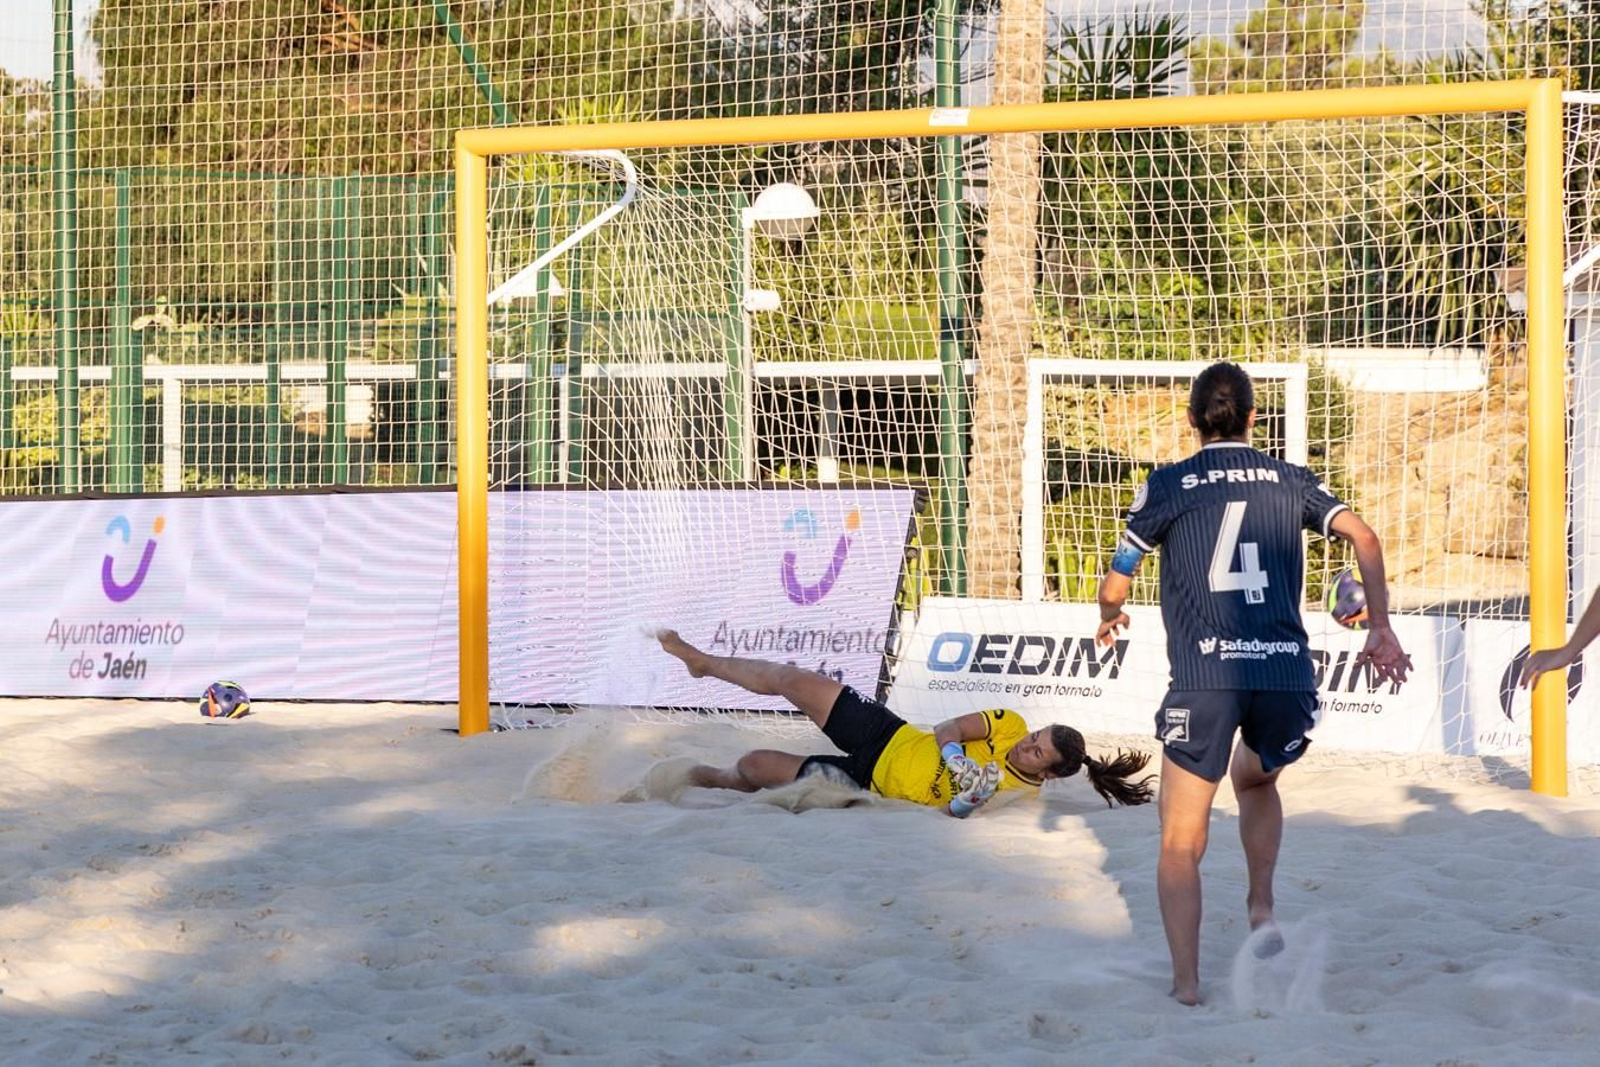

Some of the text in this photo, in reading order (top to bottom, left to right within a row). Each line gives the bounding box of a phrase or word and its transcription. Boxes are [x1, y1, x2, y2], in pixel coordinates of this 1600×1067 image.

[1181, 467, 1280, 490] S.PRIM
[1208, 500, 1270, 605] 4
[45, 617, 185, 650] Ayuntamiento
[68, 651, 147, 679] de Jaén
[926, 631, 1130, 679] OEDIM
[1220, 651, 1267, 661] promotora
[927, 677, 1102, 698] especialistas en gran formato
[1330, 699, 1383, 714] formato
